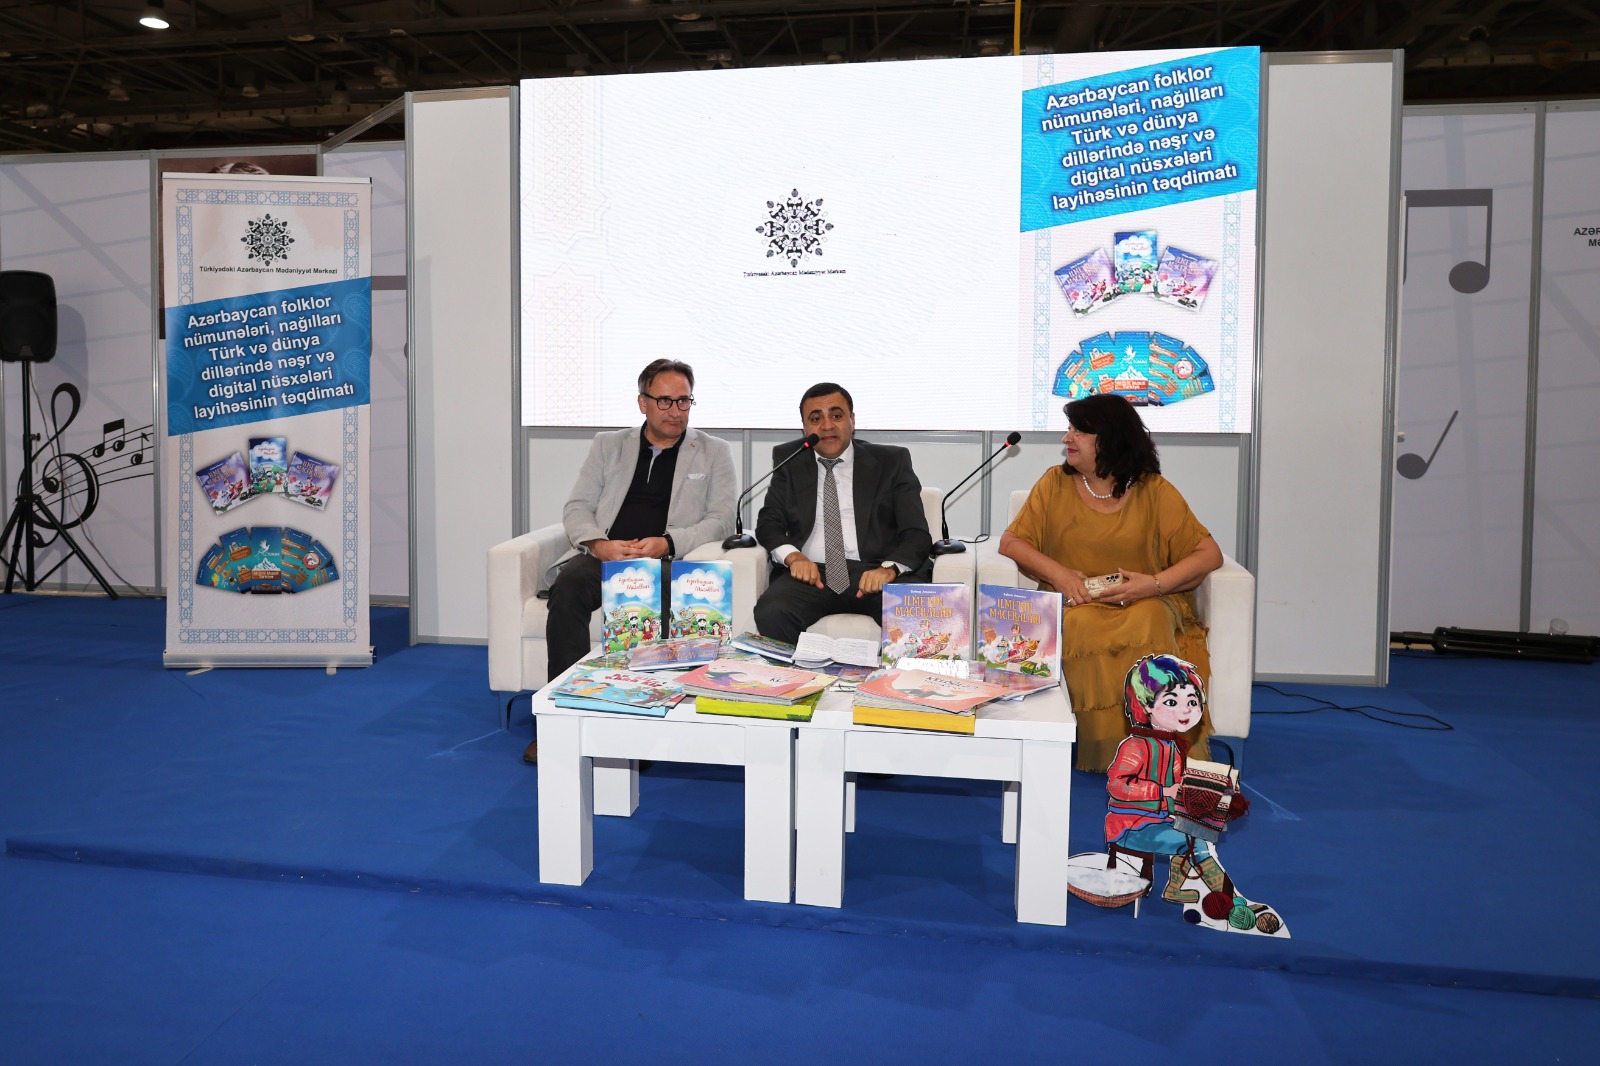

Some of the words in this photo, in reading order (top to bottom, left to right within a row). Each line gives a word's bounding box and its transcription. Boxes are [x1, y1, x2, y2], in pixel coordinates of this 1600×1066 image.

[1046, 80, 1150, 110] Azərbaycan
[1153, 65, 1213, 89] folklor
[1042, 102, 1146, 131] nümunələri,
[1151, 85, 1223, 110] nağılları
[1071, 124, 1112, 145] Türk
[1116, 121, 1138, 136] və
[1143, 111, 1198, 133] dünya
[1062, 139, 1144, 168] dillərində
[1149, 134, 1188, 152] nəşr
[1193, 128, 1215, 142] və
[1070, 162, 1125, 188] digital
[1130, 147, 1212, 175] nüsxələri
[1053, 181, 1148, 211] layihəsinin
[1152, 164, 1237, 192] təqdimatı
[184, 322, 275, 348] nümunələri,
[279, 313, 342, 333] nağılları
[187, 304, 277, 329] Azərbaycan
[281, 296, 332, 314] folklor
[201, 360, 273, 381] dillərində
[278, 356, 312, 370] nəşr
[316, 351, 335, 362] və
[209, 343, 246, 361] Türk
[249, 344, 267, 355] və
[272, 335, 320, 354] dünya
[208, 378, 257, 399] digital
[261, 367, 333, 391] nüsxələri
[194, 396, 278, 421] layihəsinin
[281, 383, 354, 404] təqdimatı
